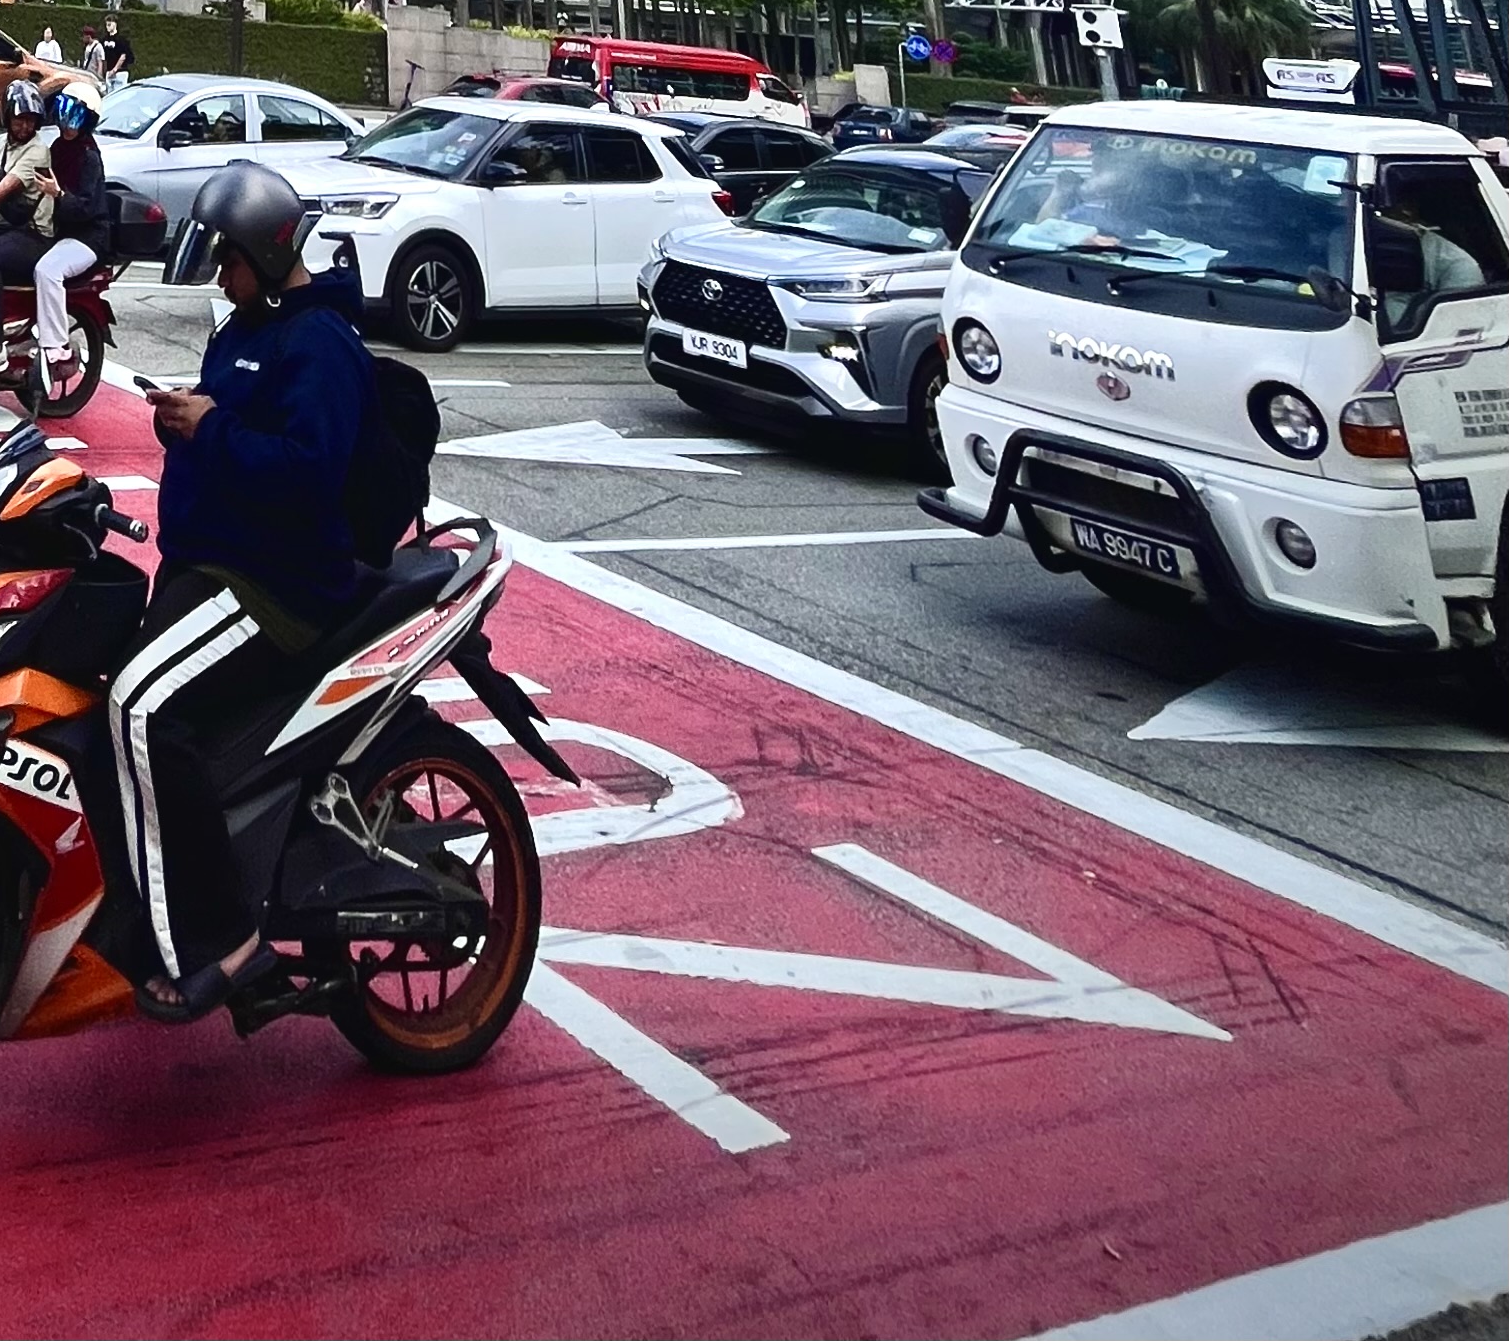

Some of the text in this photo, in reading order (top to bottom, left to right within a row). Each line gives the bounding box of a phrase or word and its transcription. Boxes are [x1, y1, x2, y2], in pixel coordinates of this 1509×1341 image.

[712, 340, 739, 360] 9304
[1074, 522, 1173, 573] WA 9947 C
